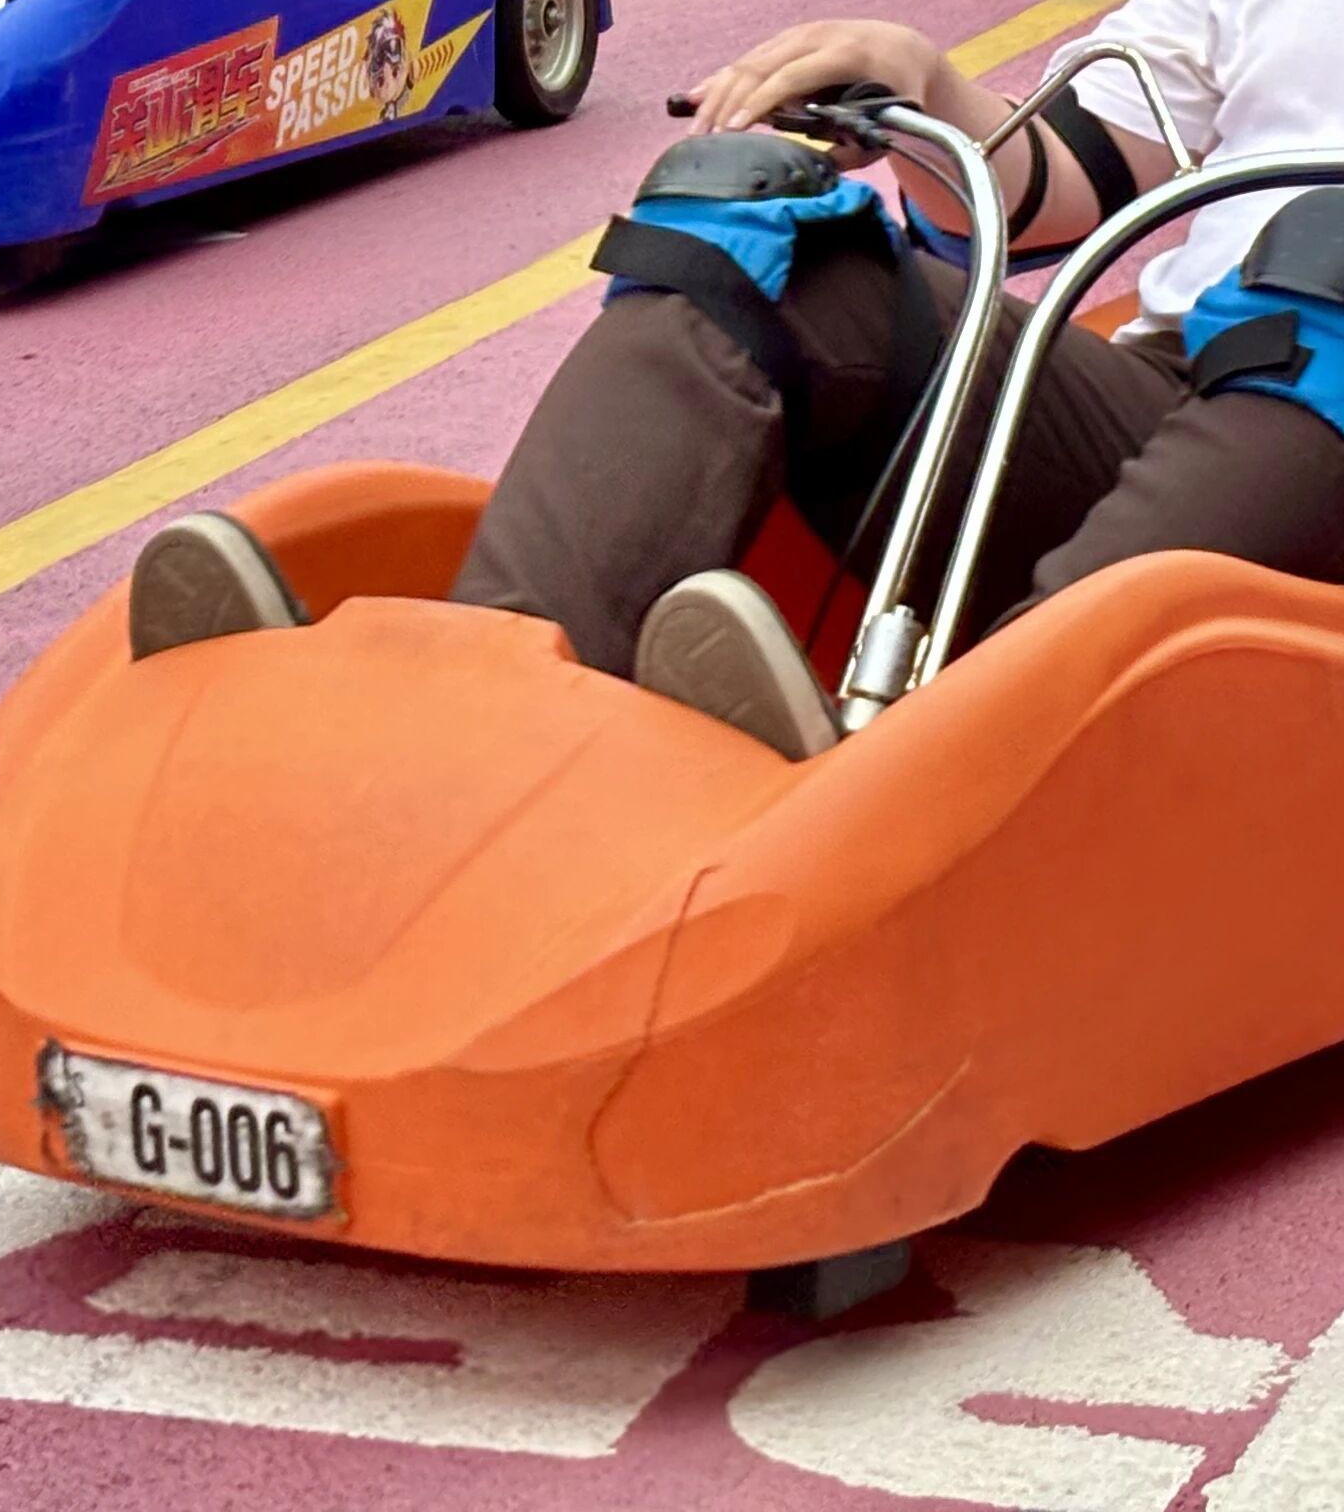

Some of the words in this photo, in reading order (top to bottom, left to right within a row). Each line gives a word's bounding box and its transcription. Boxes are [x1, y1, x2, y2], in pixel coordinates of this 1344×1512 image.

[265, 25, 359, 111] SPEED
[275, 62, 370, 149] PASSIO
[131, 1082, 301, 1200] G-006
